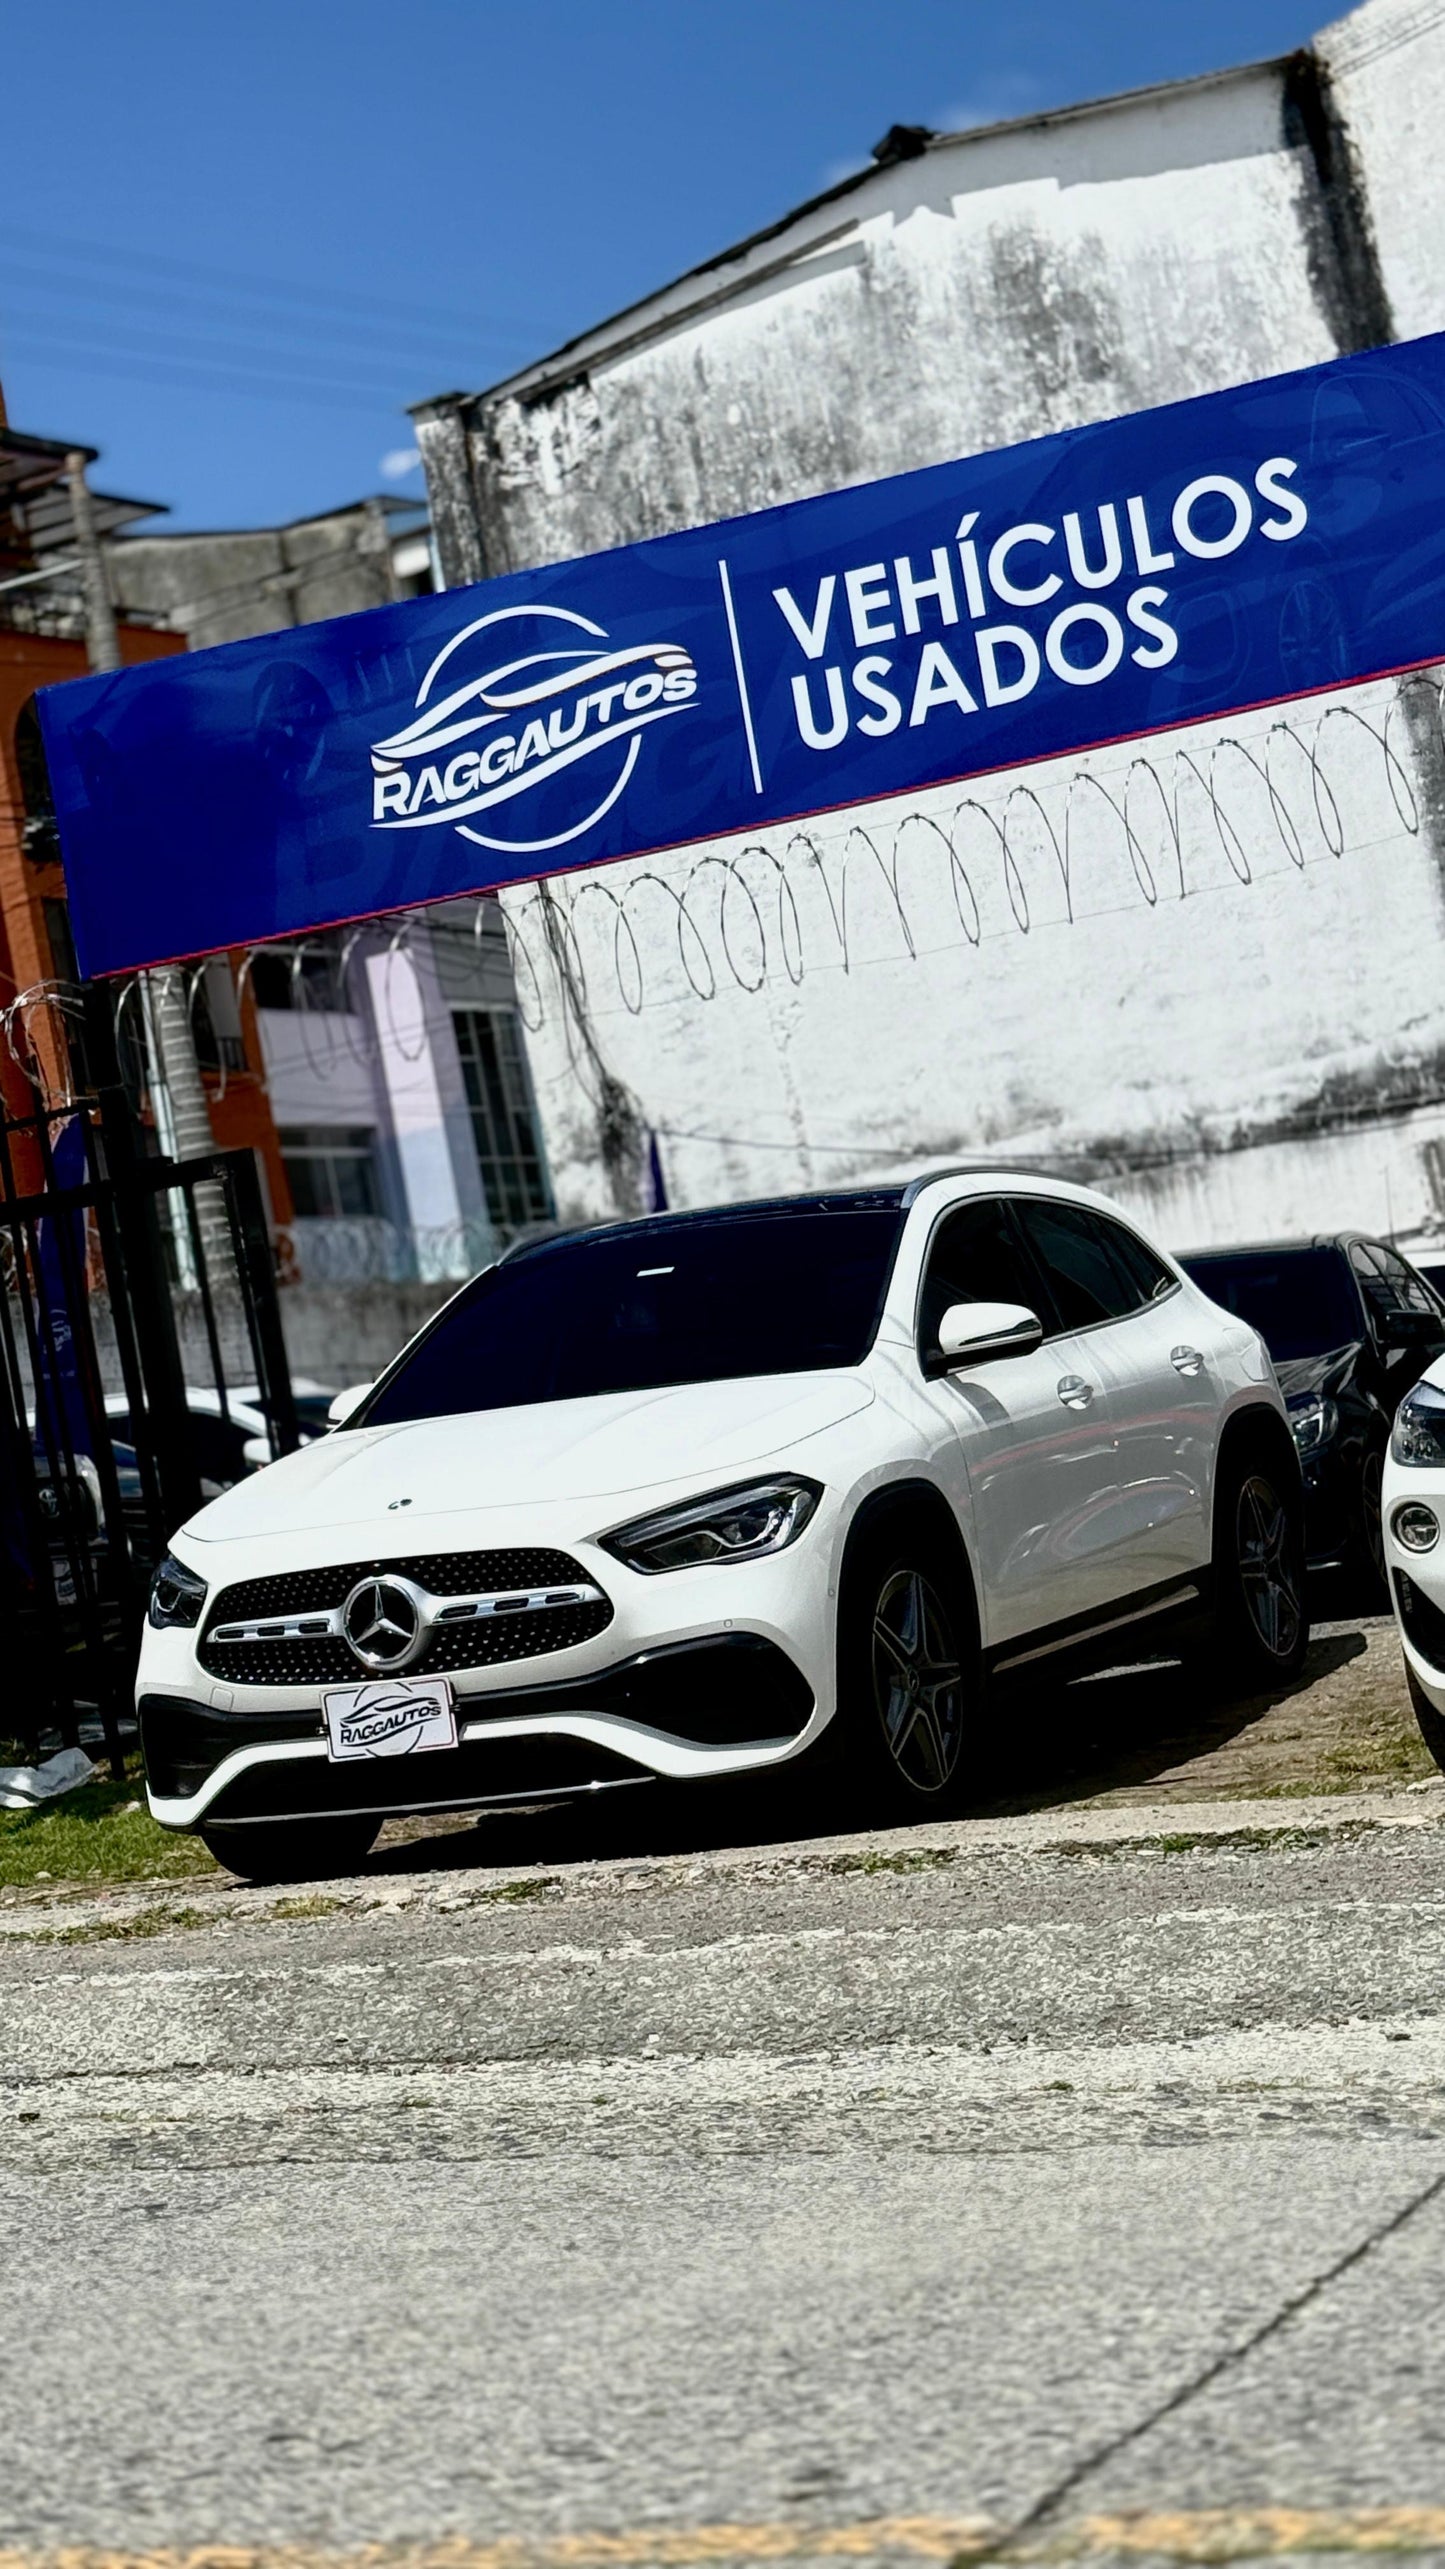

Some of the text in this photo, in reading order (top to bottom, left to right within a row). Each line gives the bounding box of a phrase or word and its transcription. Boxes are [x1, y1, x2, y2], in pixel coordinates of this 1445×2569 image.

[773, 457, 1308, 660] VEHÍCULOS
[373, 667, 698, 820] RAGGAUTOS
[790, 586, 1179, 751] USADOS
[340, 1706, 442, 1743] RAGGAUTOS
